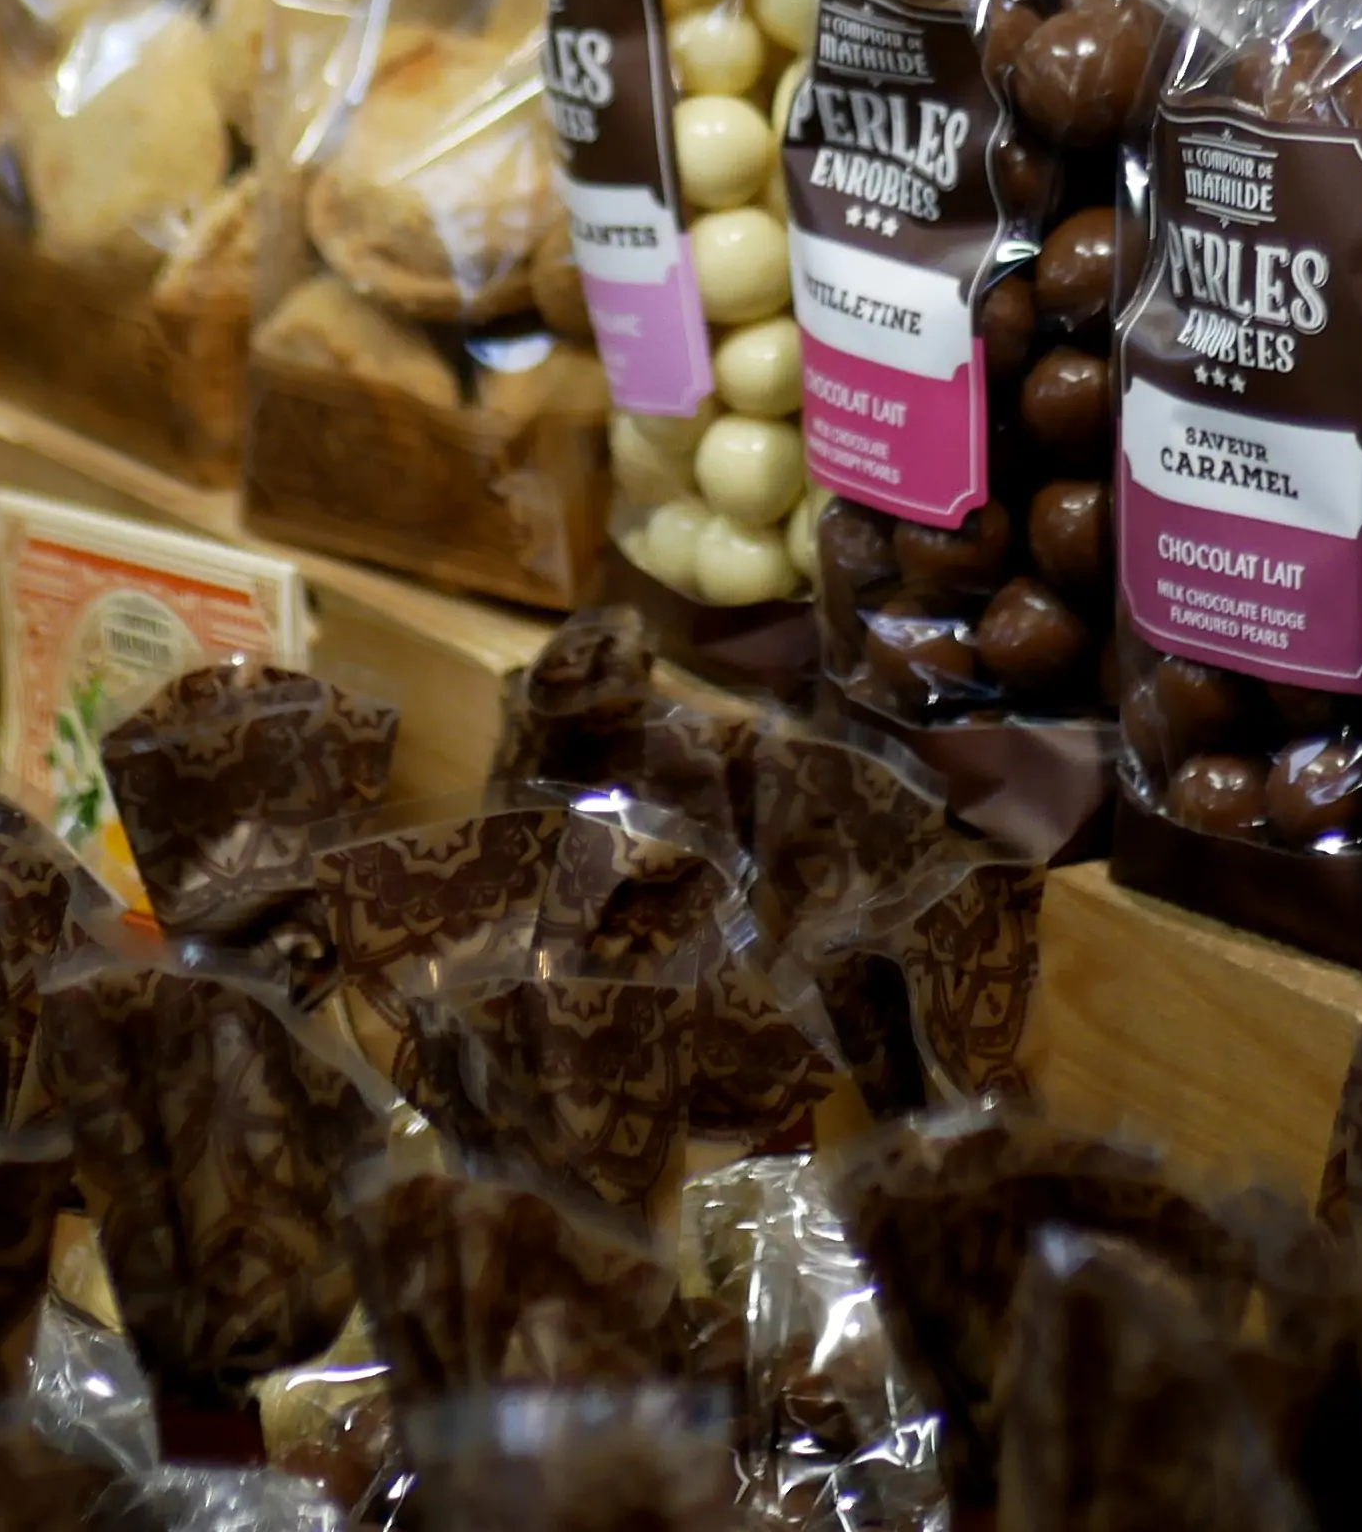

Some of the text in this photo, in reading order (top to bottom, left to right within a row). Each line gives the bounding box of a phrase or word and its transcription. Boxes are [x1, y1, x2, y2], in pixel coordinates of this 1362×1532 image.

[818, 32, 931, 77] MATHILDE
[787, 77, 971, 192] PERLES
[808, 145, 941, 223] ENROBÉES
[1184, 168, 1275, 212] MATHILDE
[1195, 147, 1255, 177] COMPTOIR
[1257, 162, 1275, 181] DE
[1166, 219, 1331, 335] PERLES
[1176, 307, 1296, 374] ENROBÉES
[1185, 426, 1269, 463] SAVEUR
[1160, 446, 1300, 501] CARAMEL
[1157, 532, 1306, 591] CHOCOLAT LAIT
[1156, 578, 1308, 632] MILK CHOCOLATE FUDGE
[1169, 605, 1290, 651] FLAVOURED PEARLS
